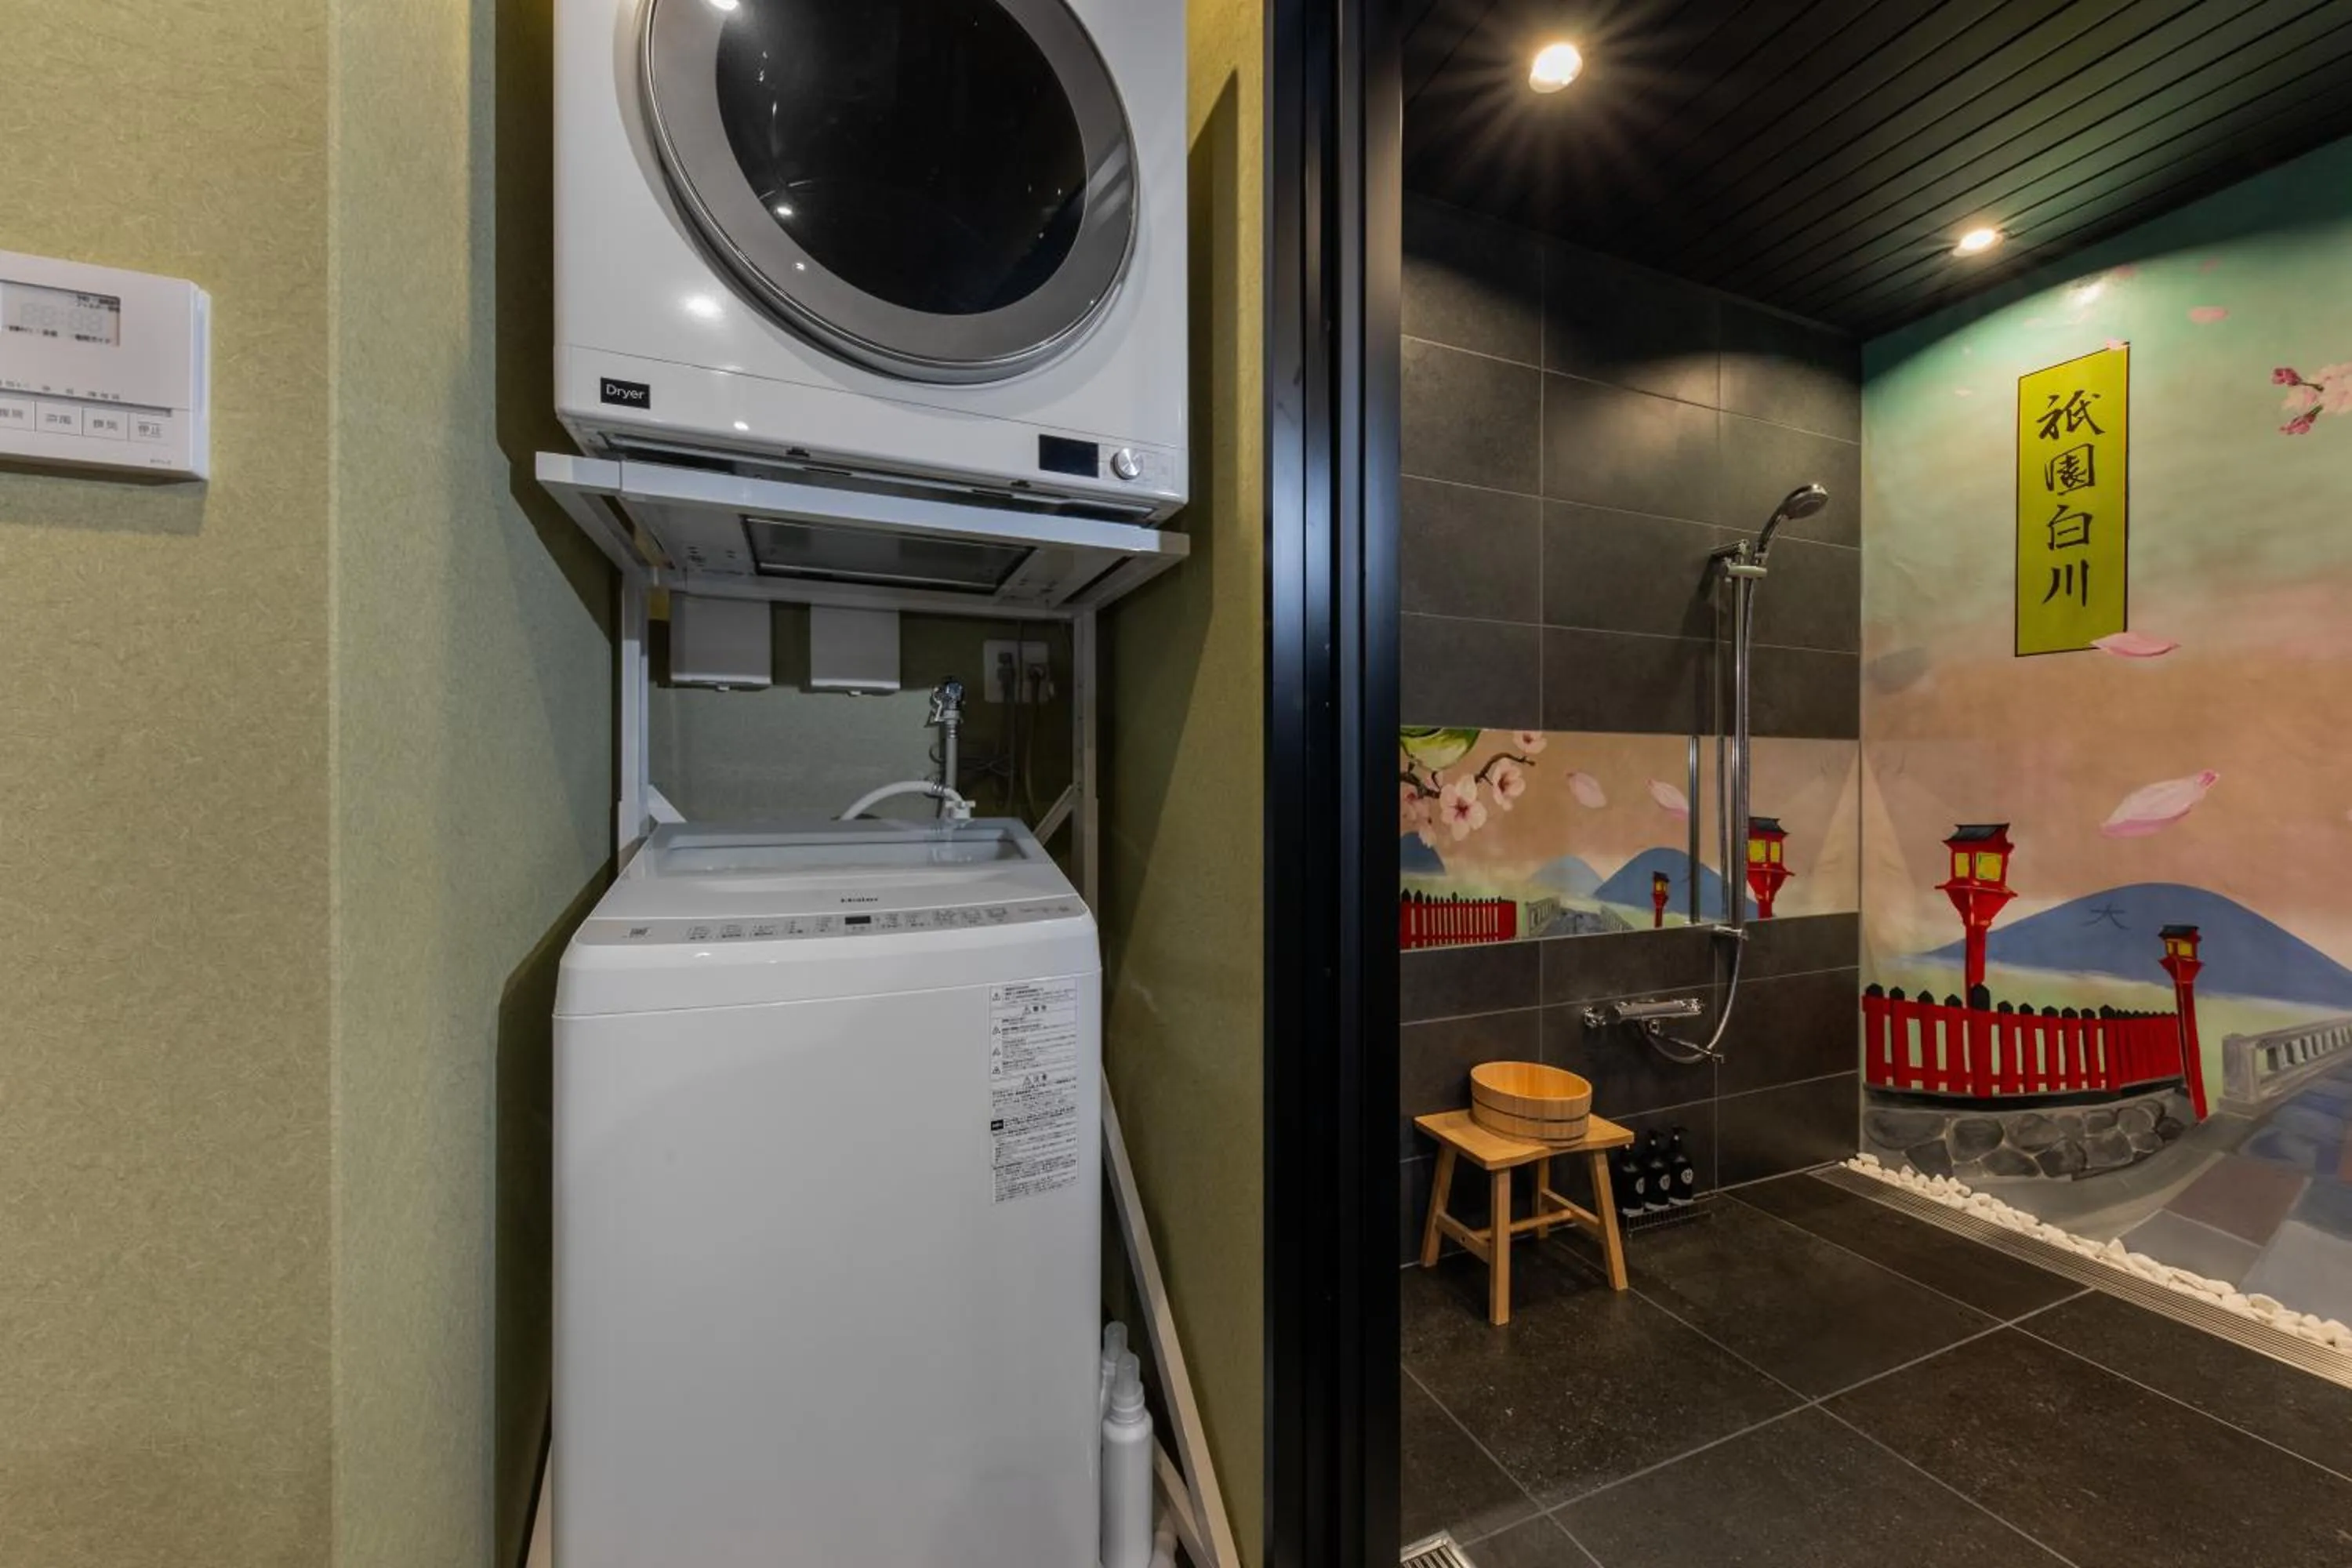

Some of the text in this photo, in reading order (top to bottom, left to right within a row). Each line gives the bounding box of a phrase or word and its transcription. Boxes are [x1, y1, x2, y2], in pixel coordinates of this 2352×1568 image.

[606, 383, 645, 400] Dryer
[2036, 390, 2106, 607] 祇園白川
